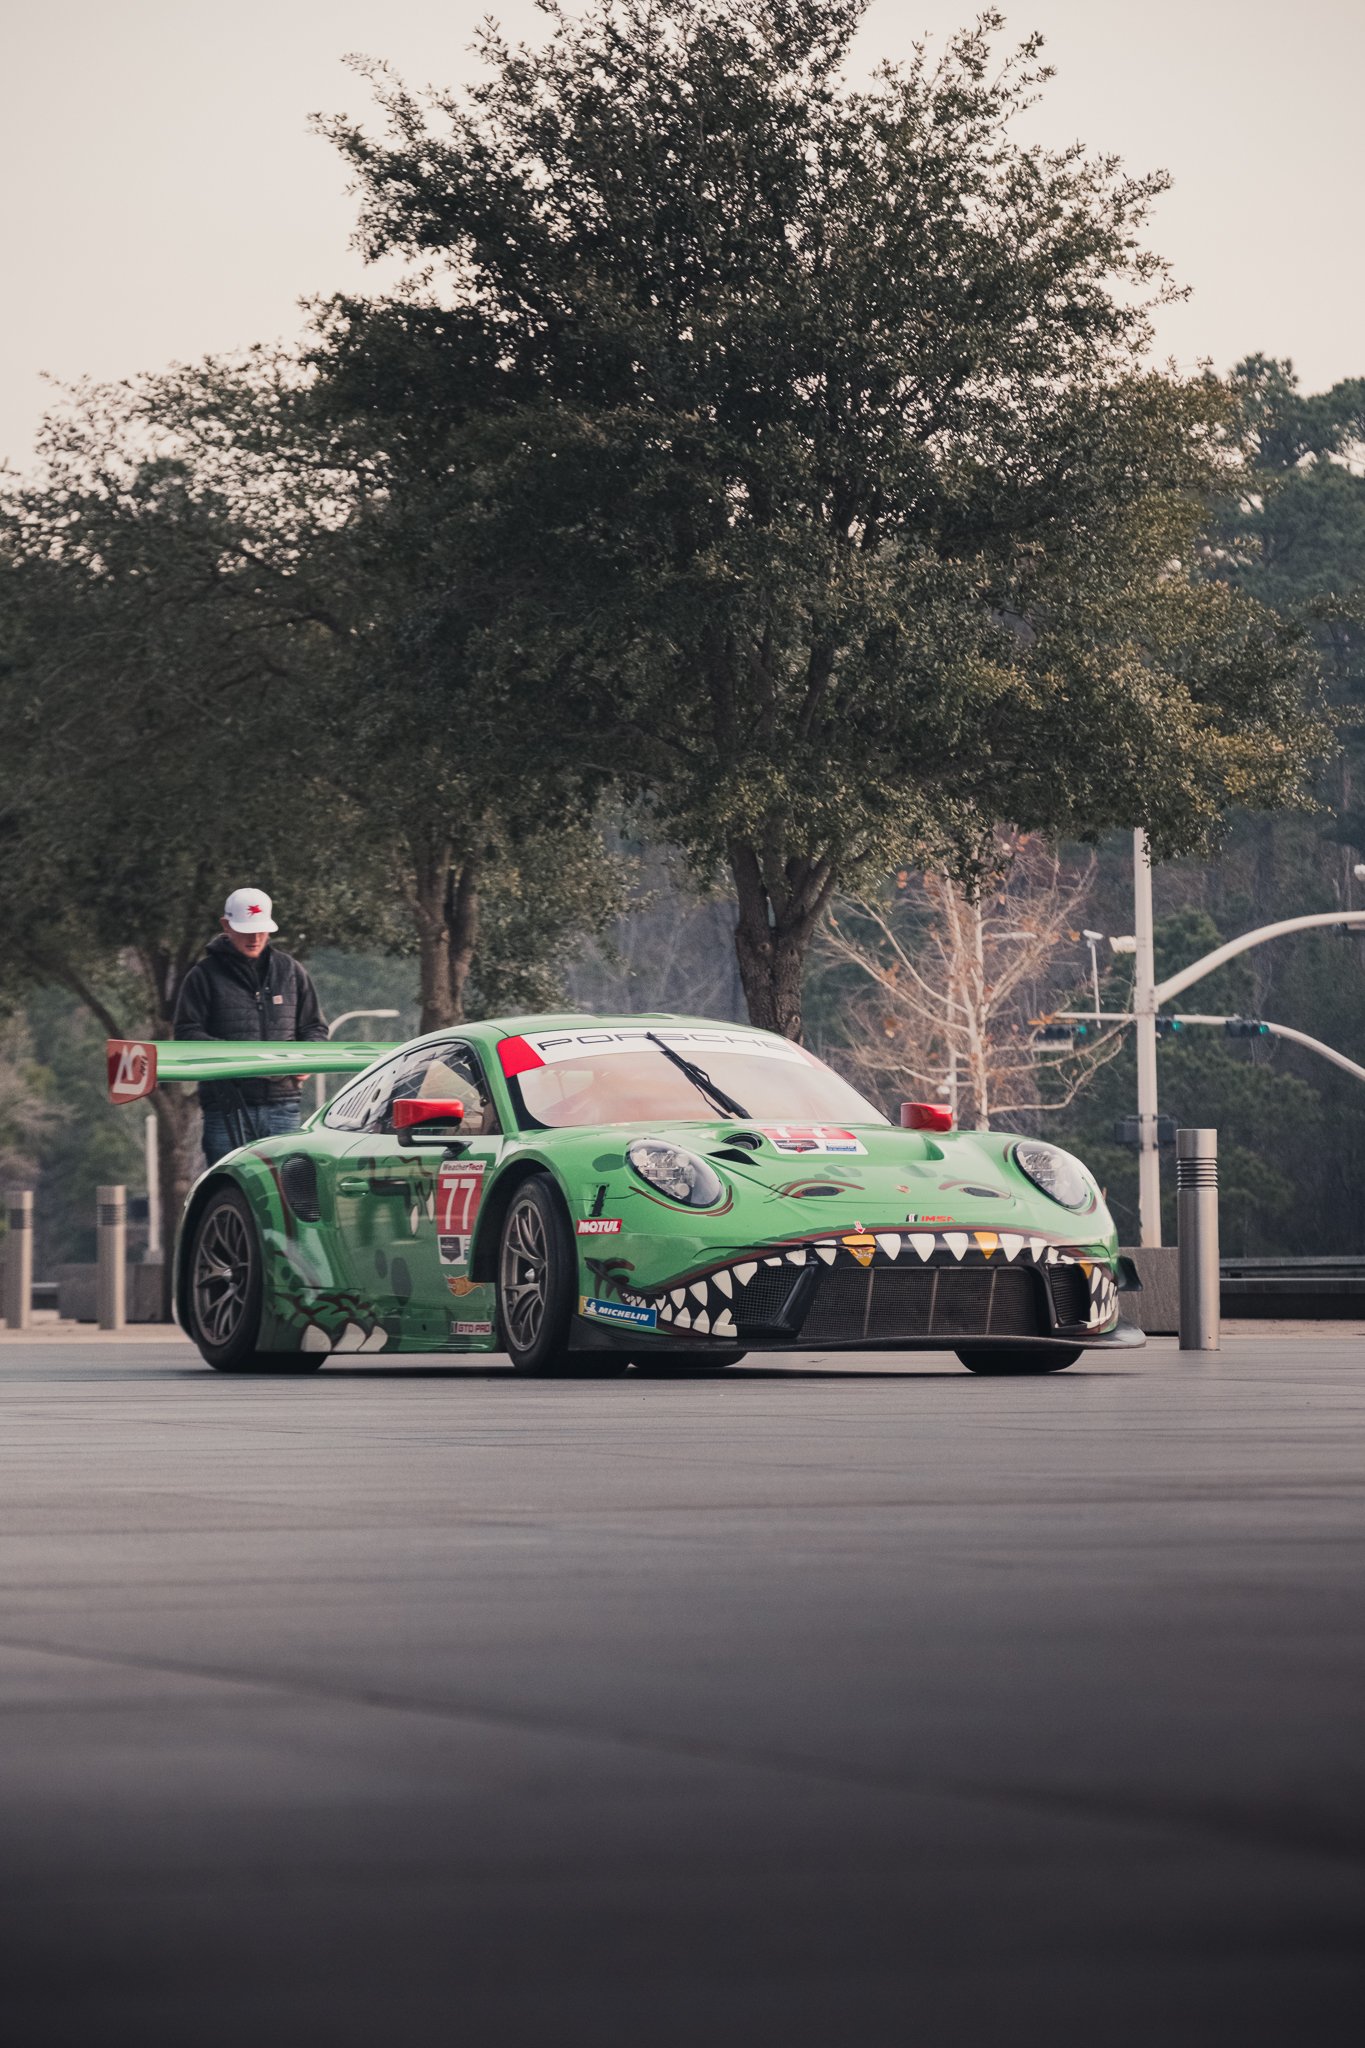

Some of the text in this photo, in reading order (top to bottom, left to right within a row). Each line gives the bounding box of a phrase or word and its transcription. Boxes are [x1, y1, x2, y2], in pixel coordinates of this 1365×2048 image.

[537, 1033, 794, 1051] PORSCHE
[443, 1178, 477, 1230] 77
[578, 1220, 620, 1233] MOTUL
[921, 1215, 956, 1223] IMSA
[598, 1306, 649, 1321] MICHELIN
